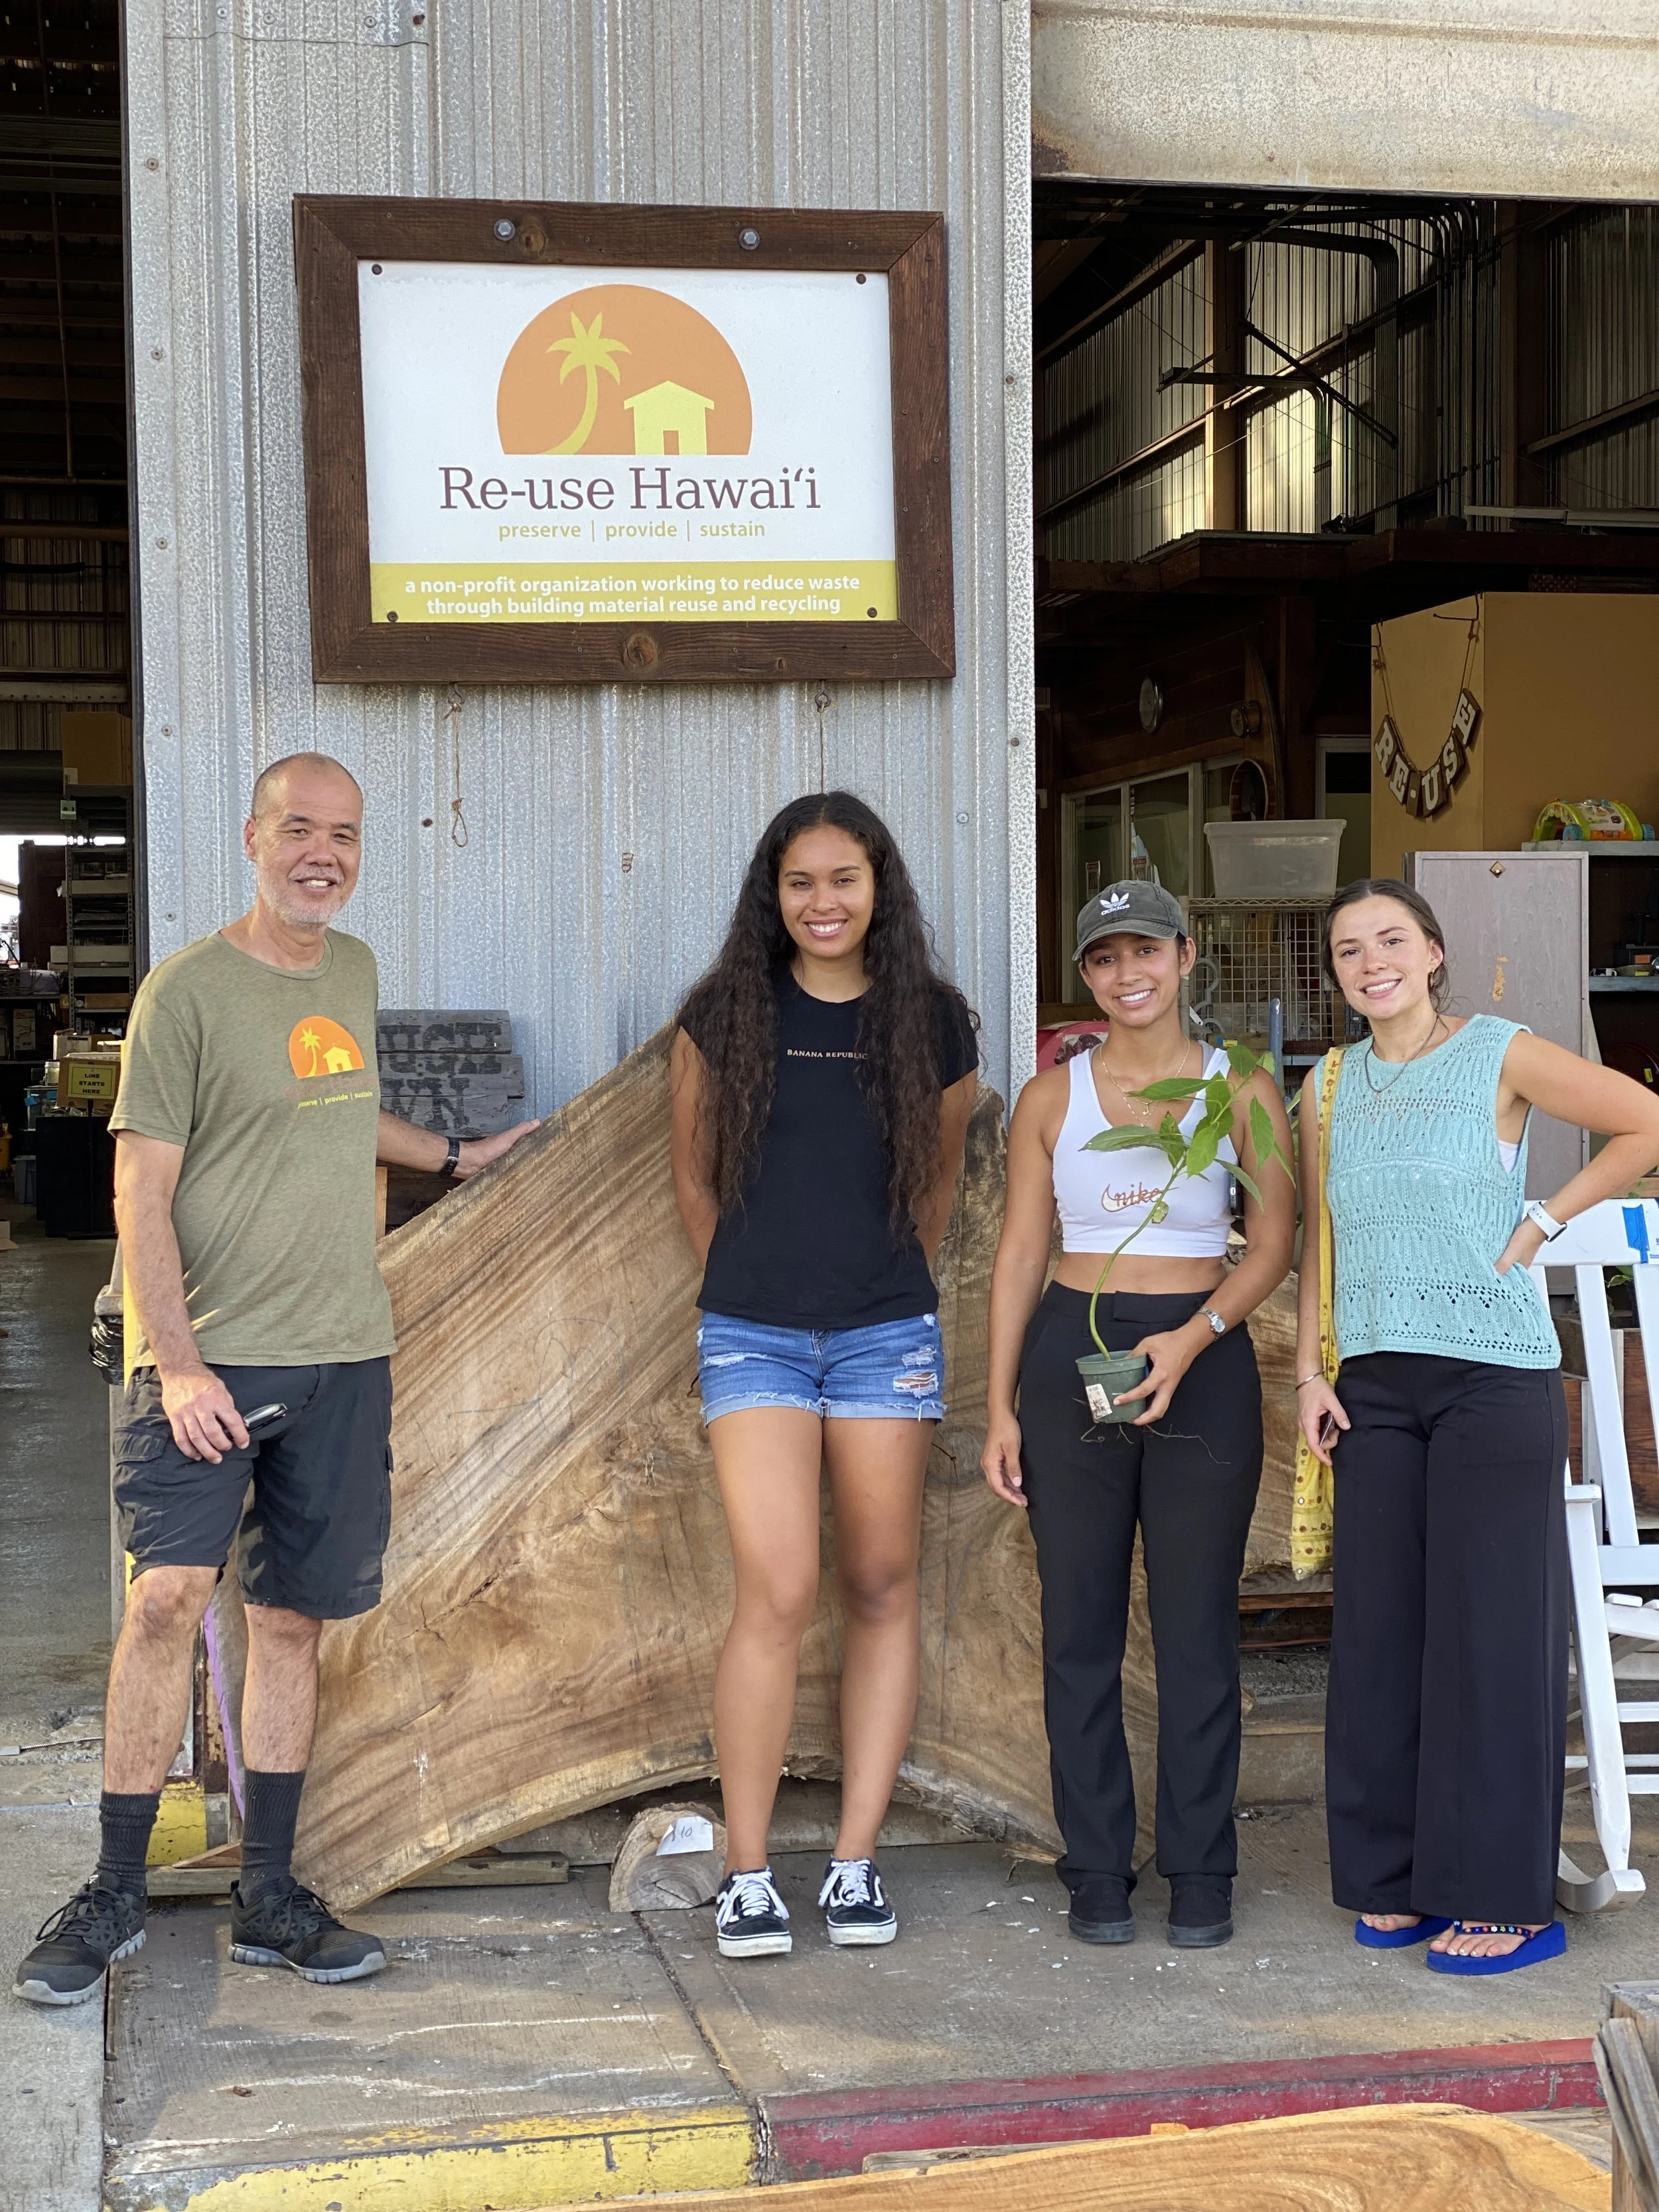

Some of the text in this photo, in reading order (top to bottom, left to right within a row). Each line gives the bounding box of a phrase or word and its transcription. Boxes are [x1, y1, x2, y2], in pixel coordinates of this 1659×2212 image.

[438, 467, 614, 510] Re-use
[498, 520, 765, 542] preserve provide sustain
[405, 575, 860, 596] a non-profit organization working to reduce waste
[427, 595, 841, 617] through building material reuse and recycling
[1100, 903, 1130, 915] adidas
[787, 1049, 868, 1060] BANANA REPUBLIC
[325, 1093, 348, 1104] provide
